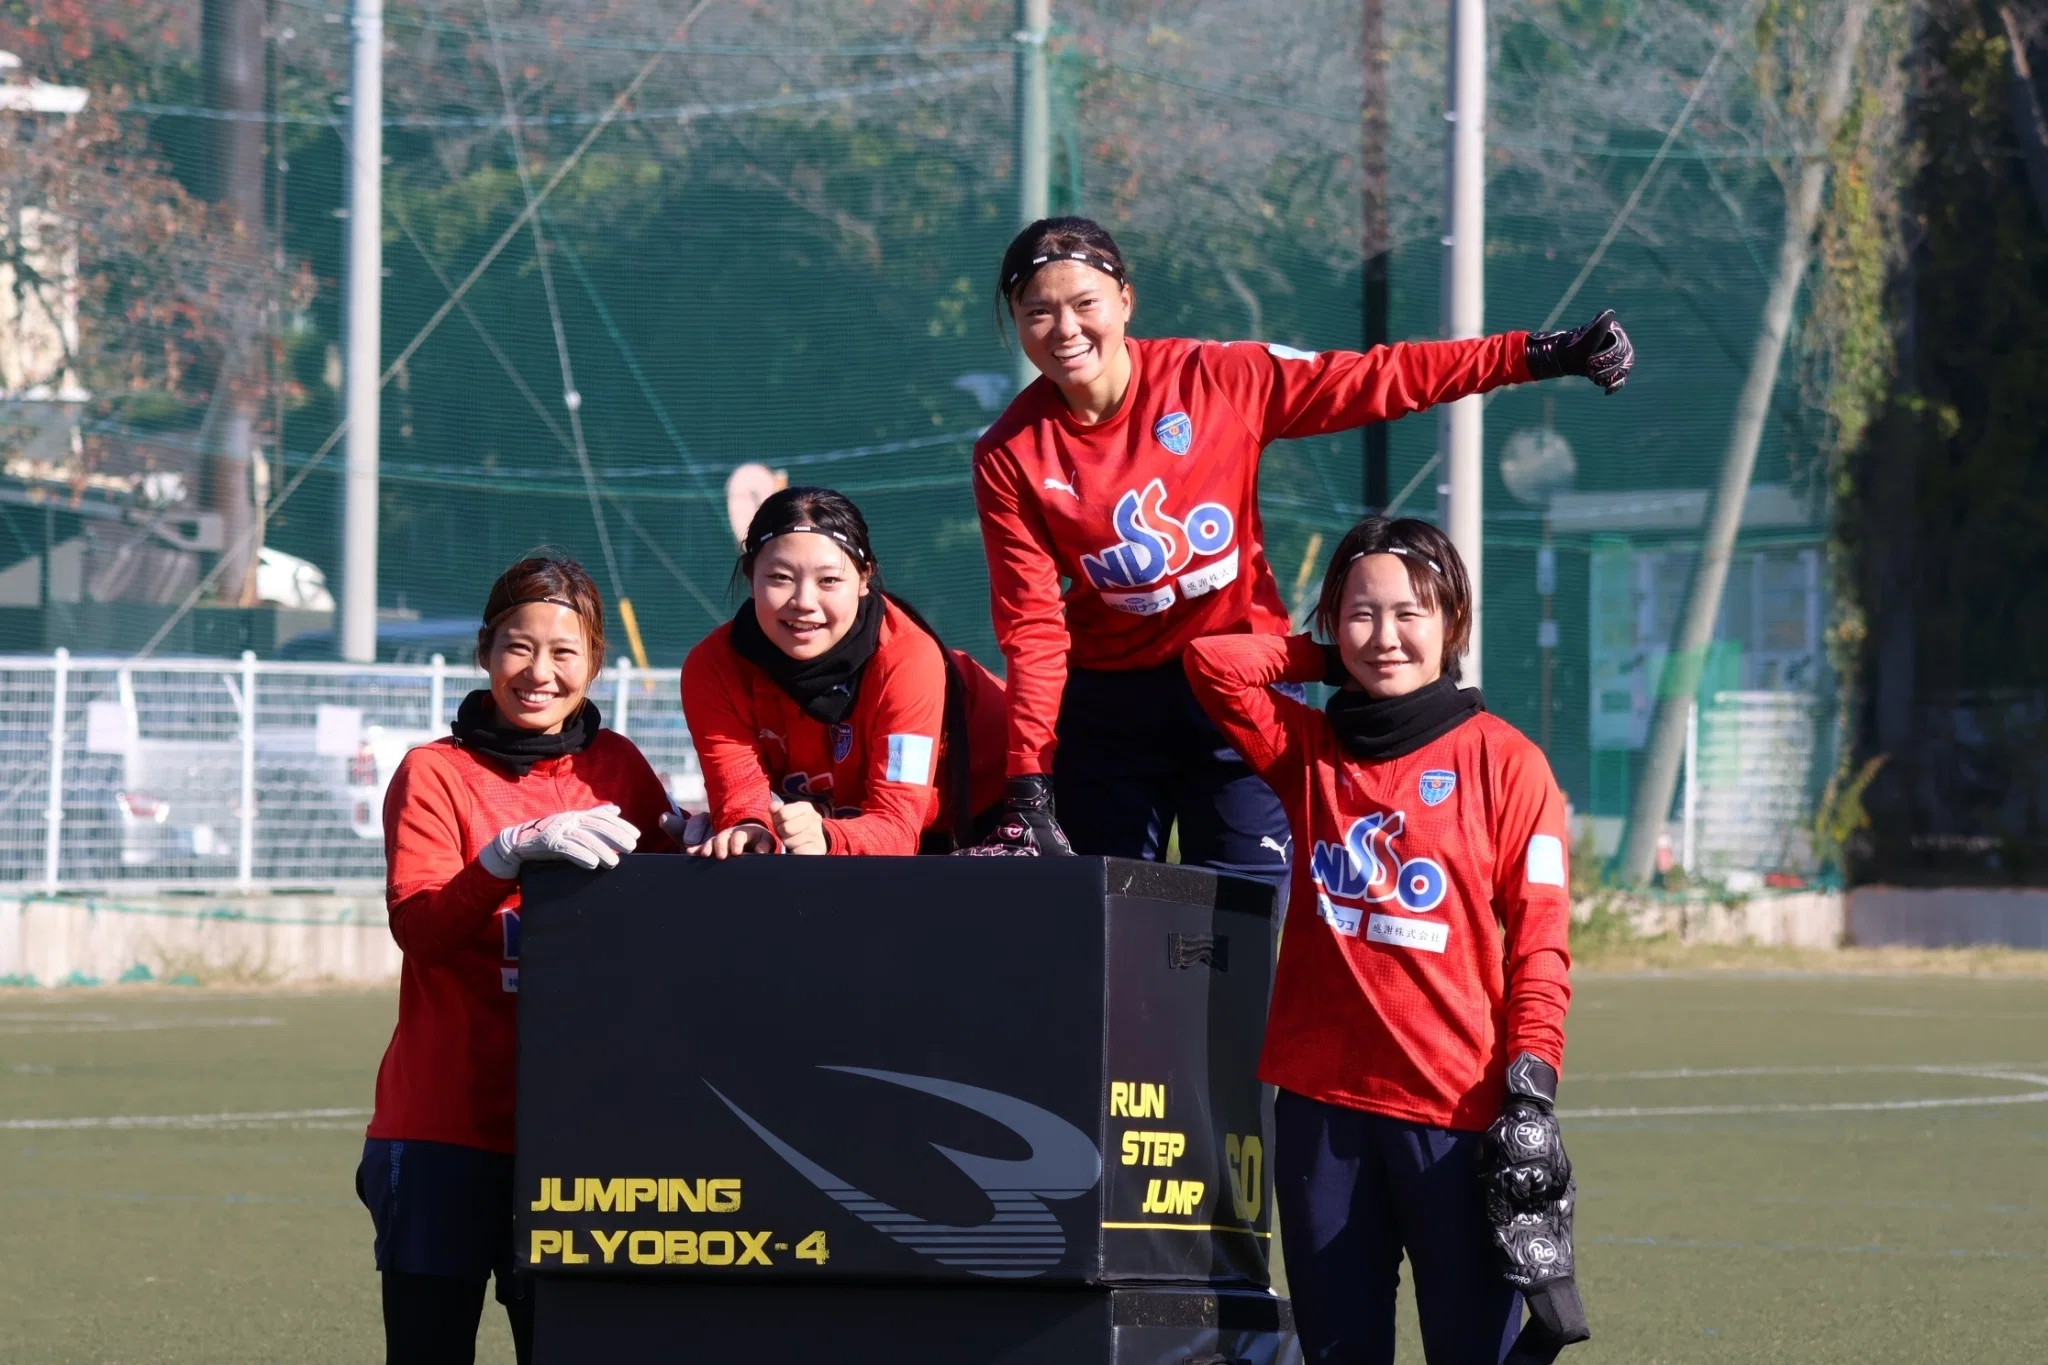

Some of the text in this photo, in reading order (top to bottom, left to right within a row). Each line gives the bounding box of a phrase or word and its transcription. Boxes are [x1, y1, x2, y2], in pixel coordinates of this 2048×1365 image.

[1372, 923, 1441, 943] 感謝株式会社
[1110, 1081, 1165, 1119] RUN
[1121, 1130, 1186, 1167] STEP
[531, 1177, 741, 1213] JUMPING
[1142, 1179, 1205, 1215] JUMP
